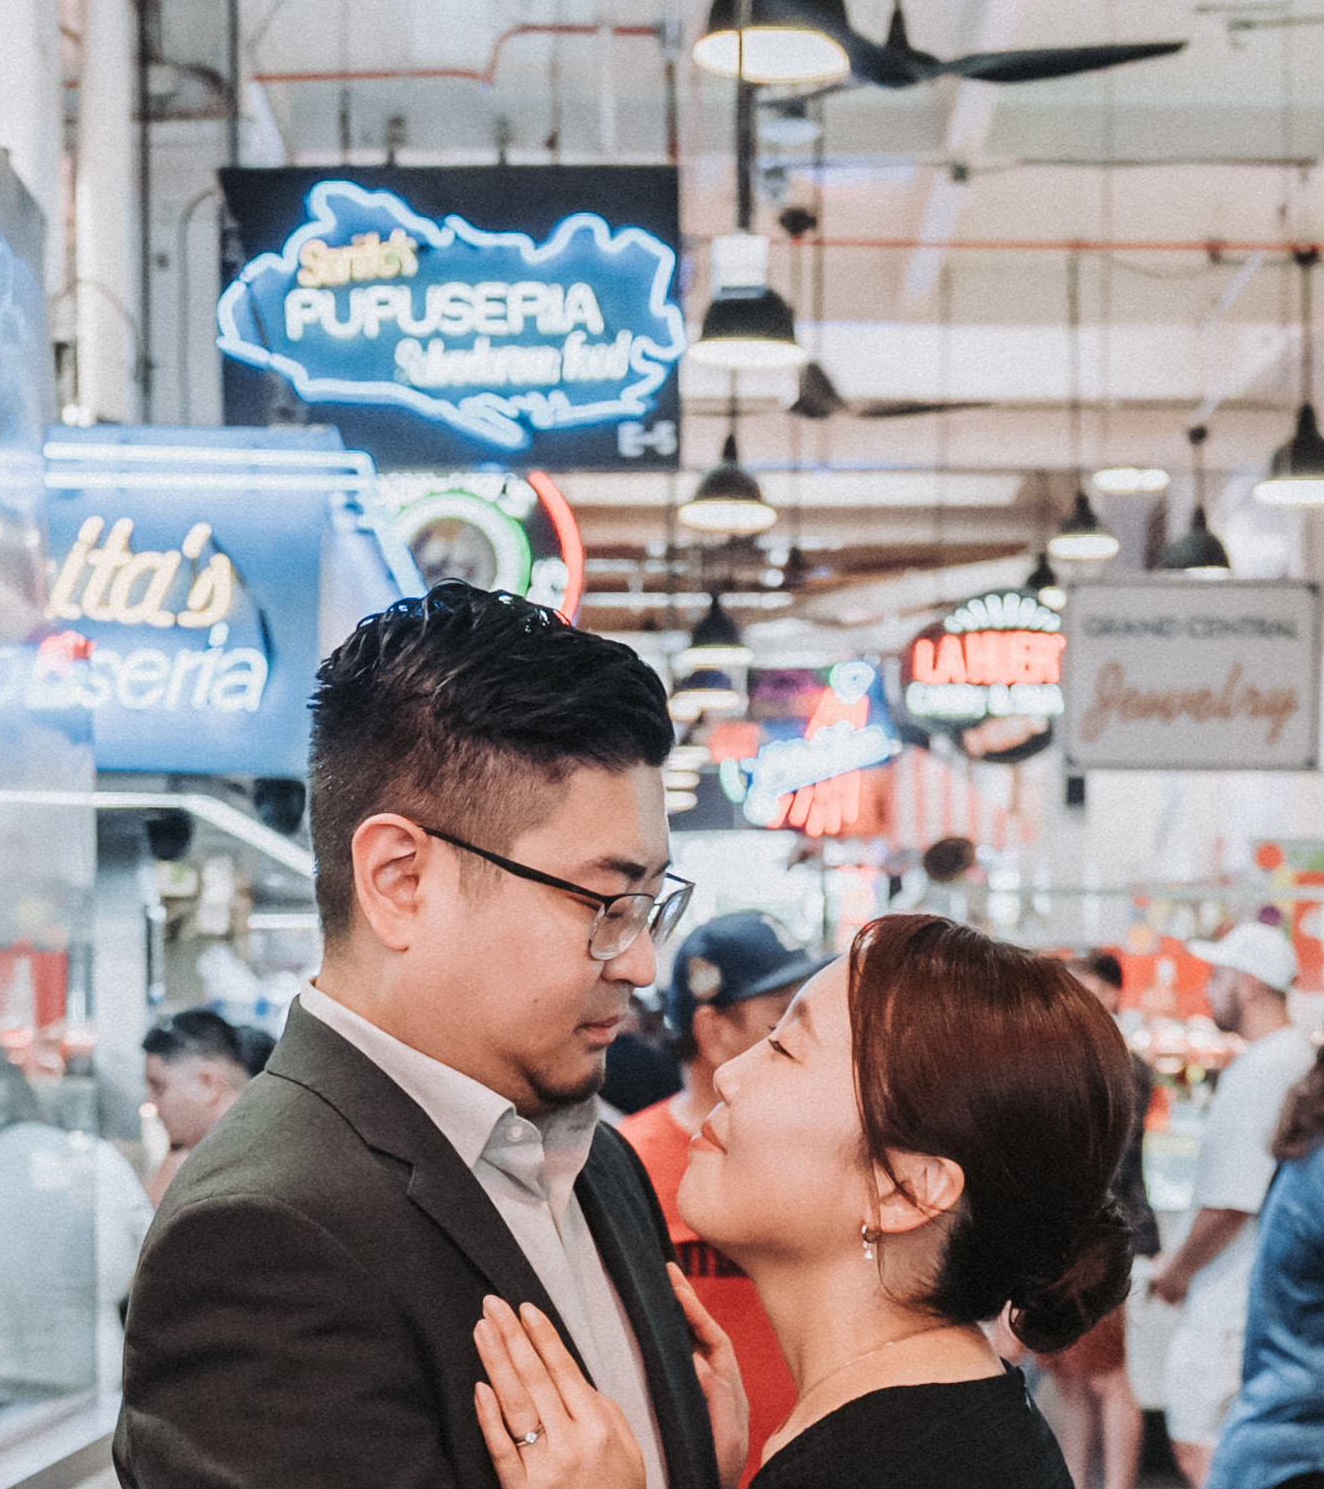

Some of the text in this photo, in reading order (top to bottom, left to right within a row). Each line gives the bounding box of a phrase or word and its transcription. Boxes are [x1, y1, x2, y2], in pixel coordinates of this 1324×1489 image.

[284, 281, 604, 341] PUPUSERIA
[44, 514, 233, 629] ita's
[1084, 615, 1298, 639] GRAND CENTRAL
[1079, 659, 1299, 744] Jewelry
